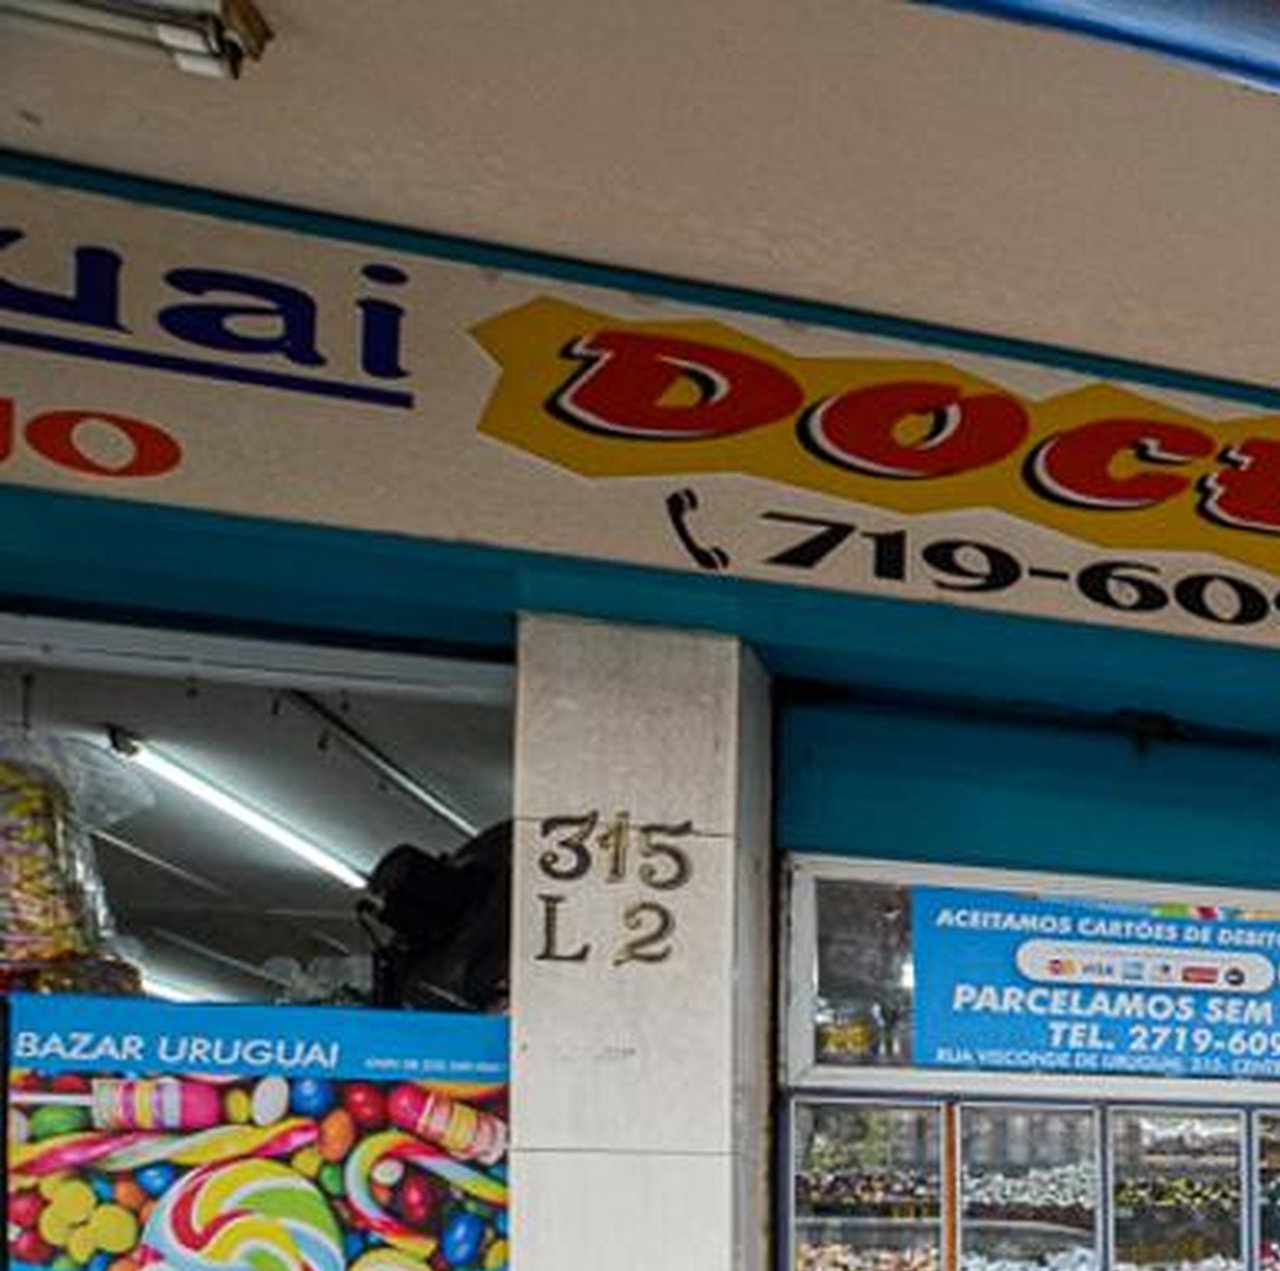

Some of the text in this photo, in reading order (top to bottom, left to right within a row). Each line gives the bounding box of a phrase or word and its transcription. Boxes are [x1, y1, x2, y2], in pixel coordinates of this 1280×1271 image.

[538, 809, 693, 890] 315
[533, 893, 677, 967] L 2
[936, 908, 1073, 933] ACEITAMOS
[1078, 914, 1179, 941] CARTÕES
[1183, 925, 1212, 944] DE
[952, 984, 1194, 1022] PARCELAMOS
[1205, 996, 1273, 1026] SEM
[14, 1031, 144, 1061] BAZAR
[157, 1034, 340, 1069] URUGUAI
[1050, 1020, 1115, 1050] TEL.
